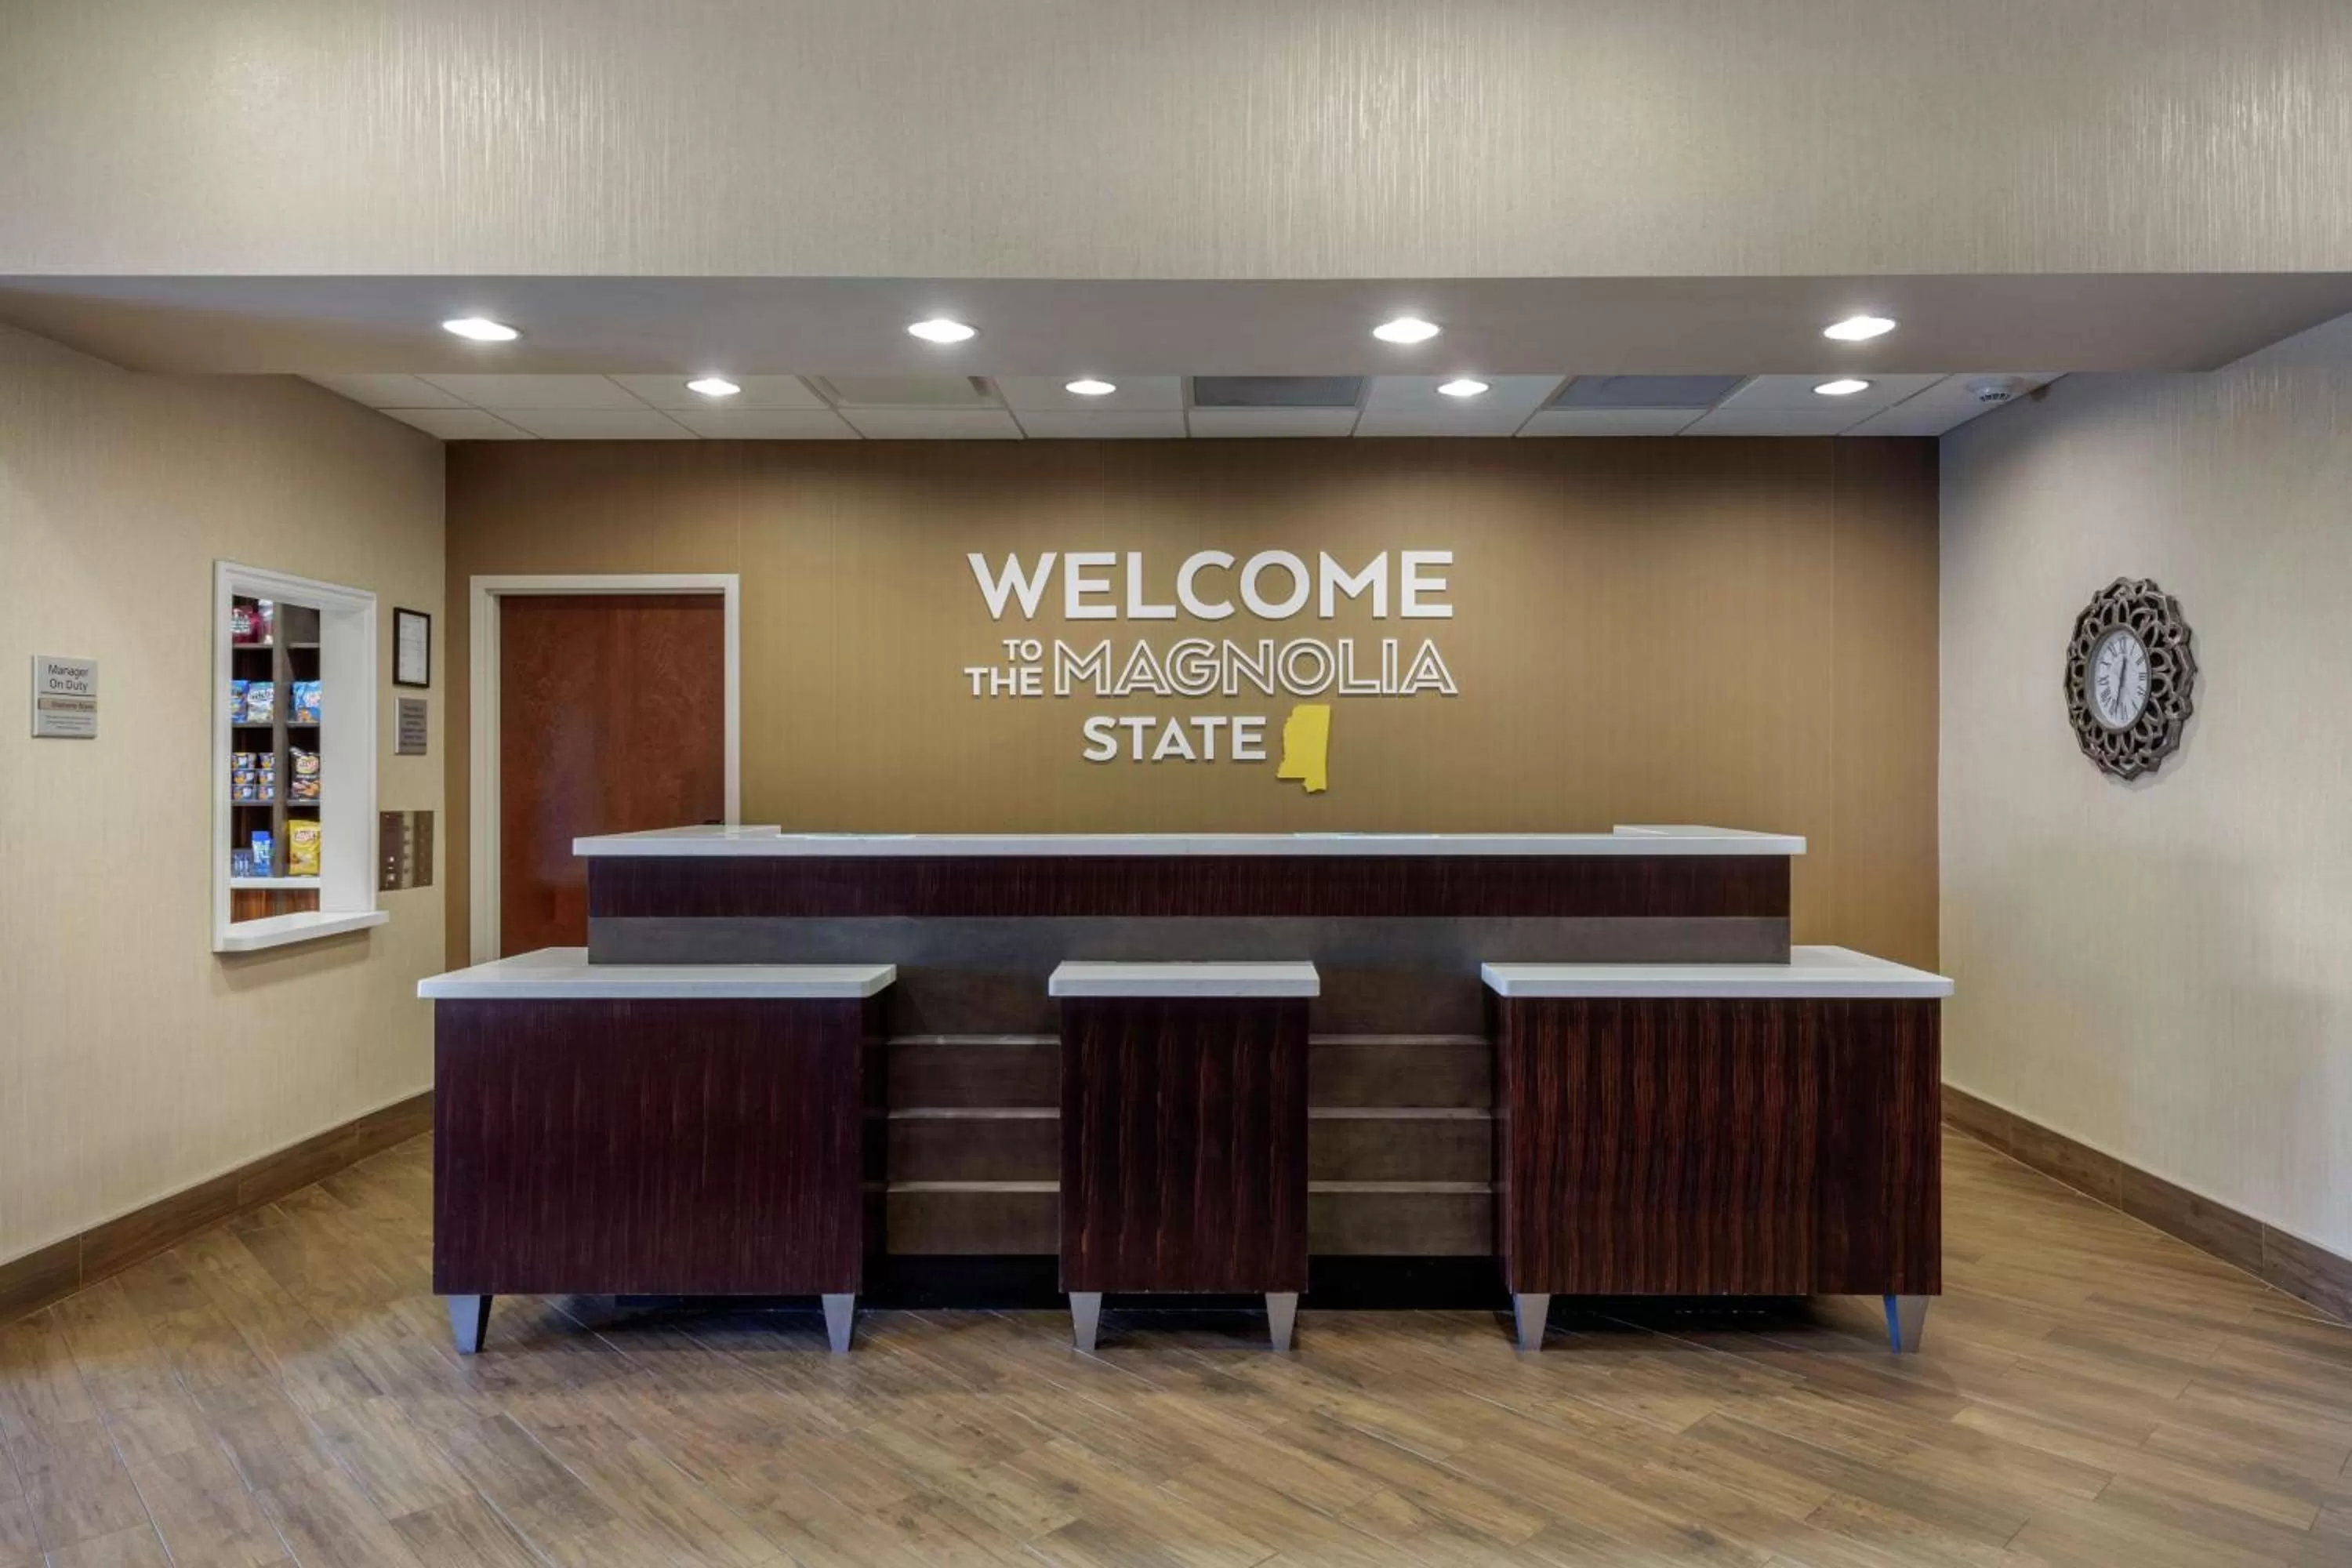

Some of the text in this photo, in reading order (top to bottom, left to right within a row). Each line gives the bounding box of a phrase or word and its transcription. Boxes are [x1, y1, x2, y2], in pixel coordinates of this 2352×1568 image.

[966, 550, 1455, 619] WELCOME
[964, 637, 1459, 695] THE MAGNOLIA
[1003, 638, 1043, 661] TO
[48, 664, 88, 679] Manager
[49, 678, 88, 693] On Duty
[1083, 715, 1266, 761] STATE
